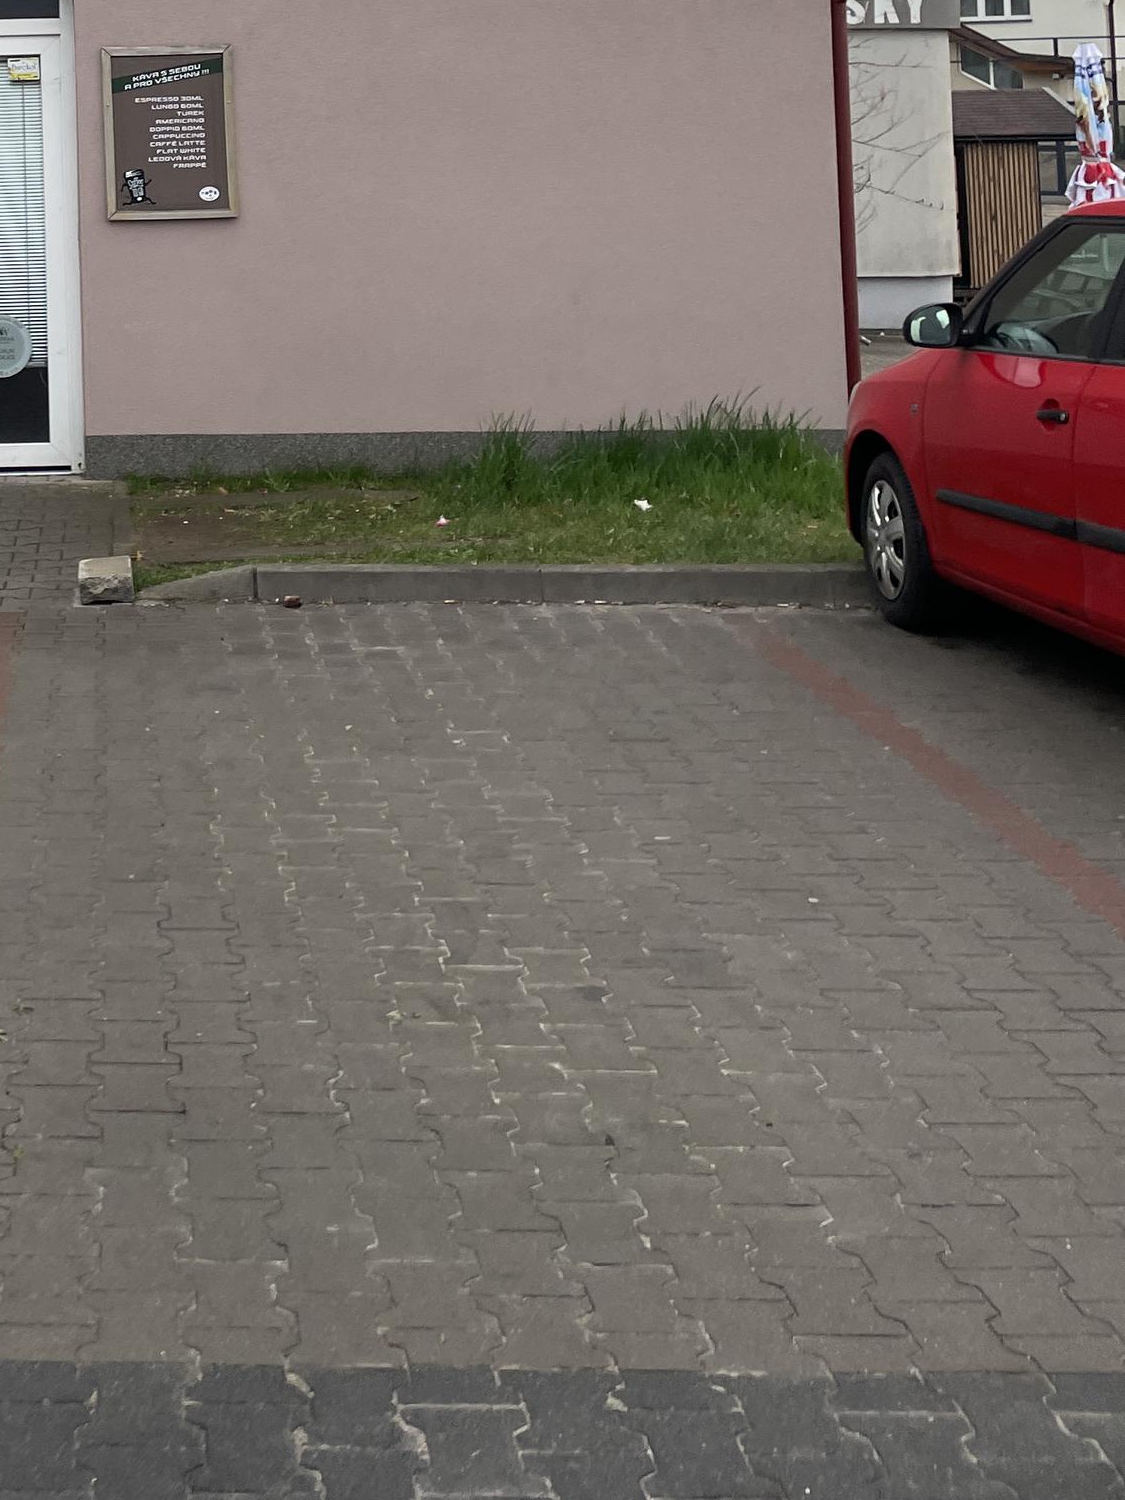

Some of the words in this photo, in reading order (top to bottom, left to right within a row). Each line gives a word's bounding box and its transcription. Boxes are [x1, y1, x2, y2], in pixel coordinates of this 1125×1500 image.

[160, 69, 167, 77] S
[168, 63, 201, 75] SEBOU
[133, 80, 153, 89] PRO
[152, 132, 206, 140] CAPPUCCINO
